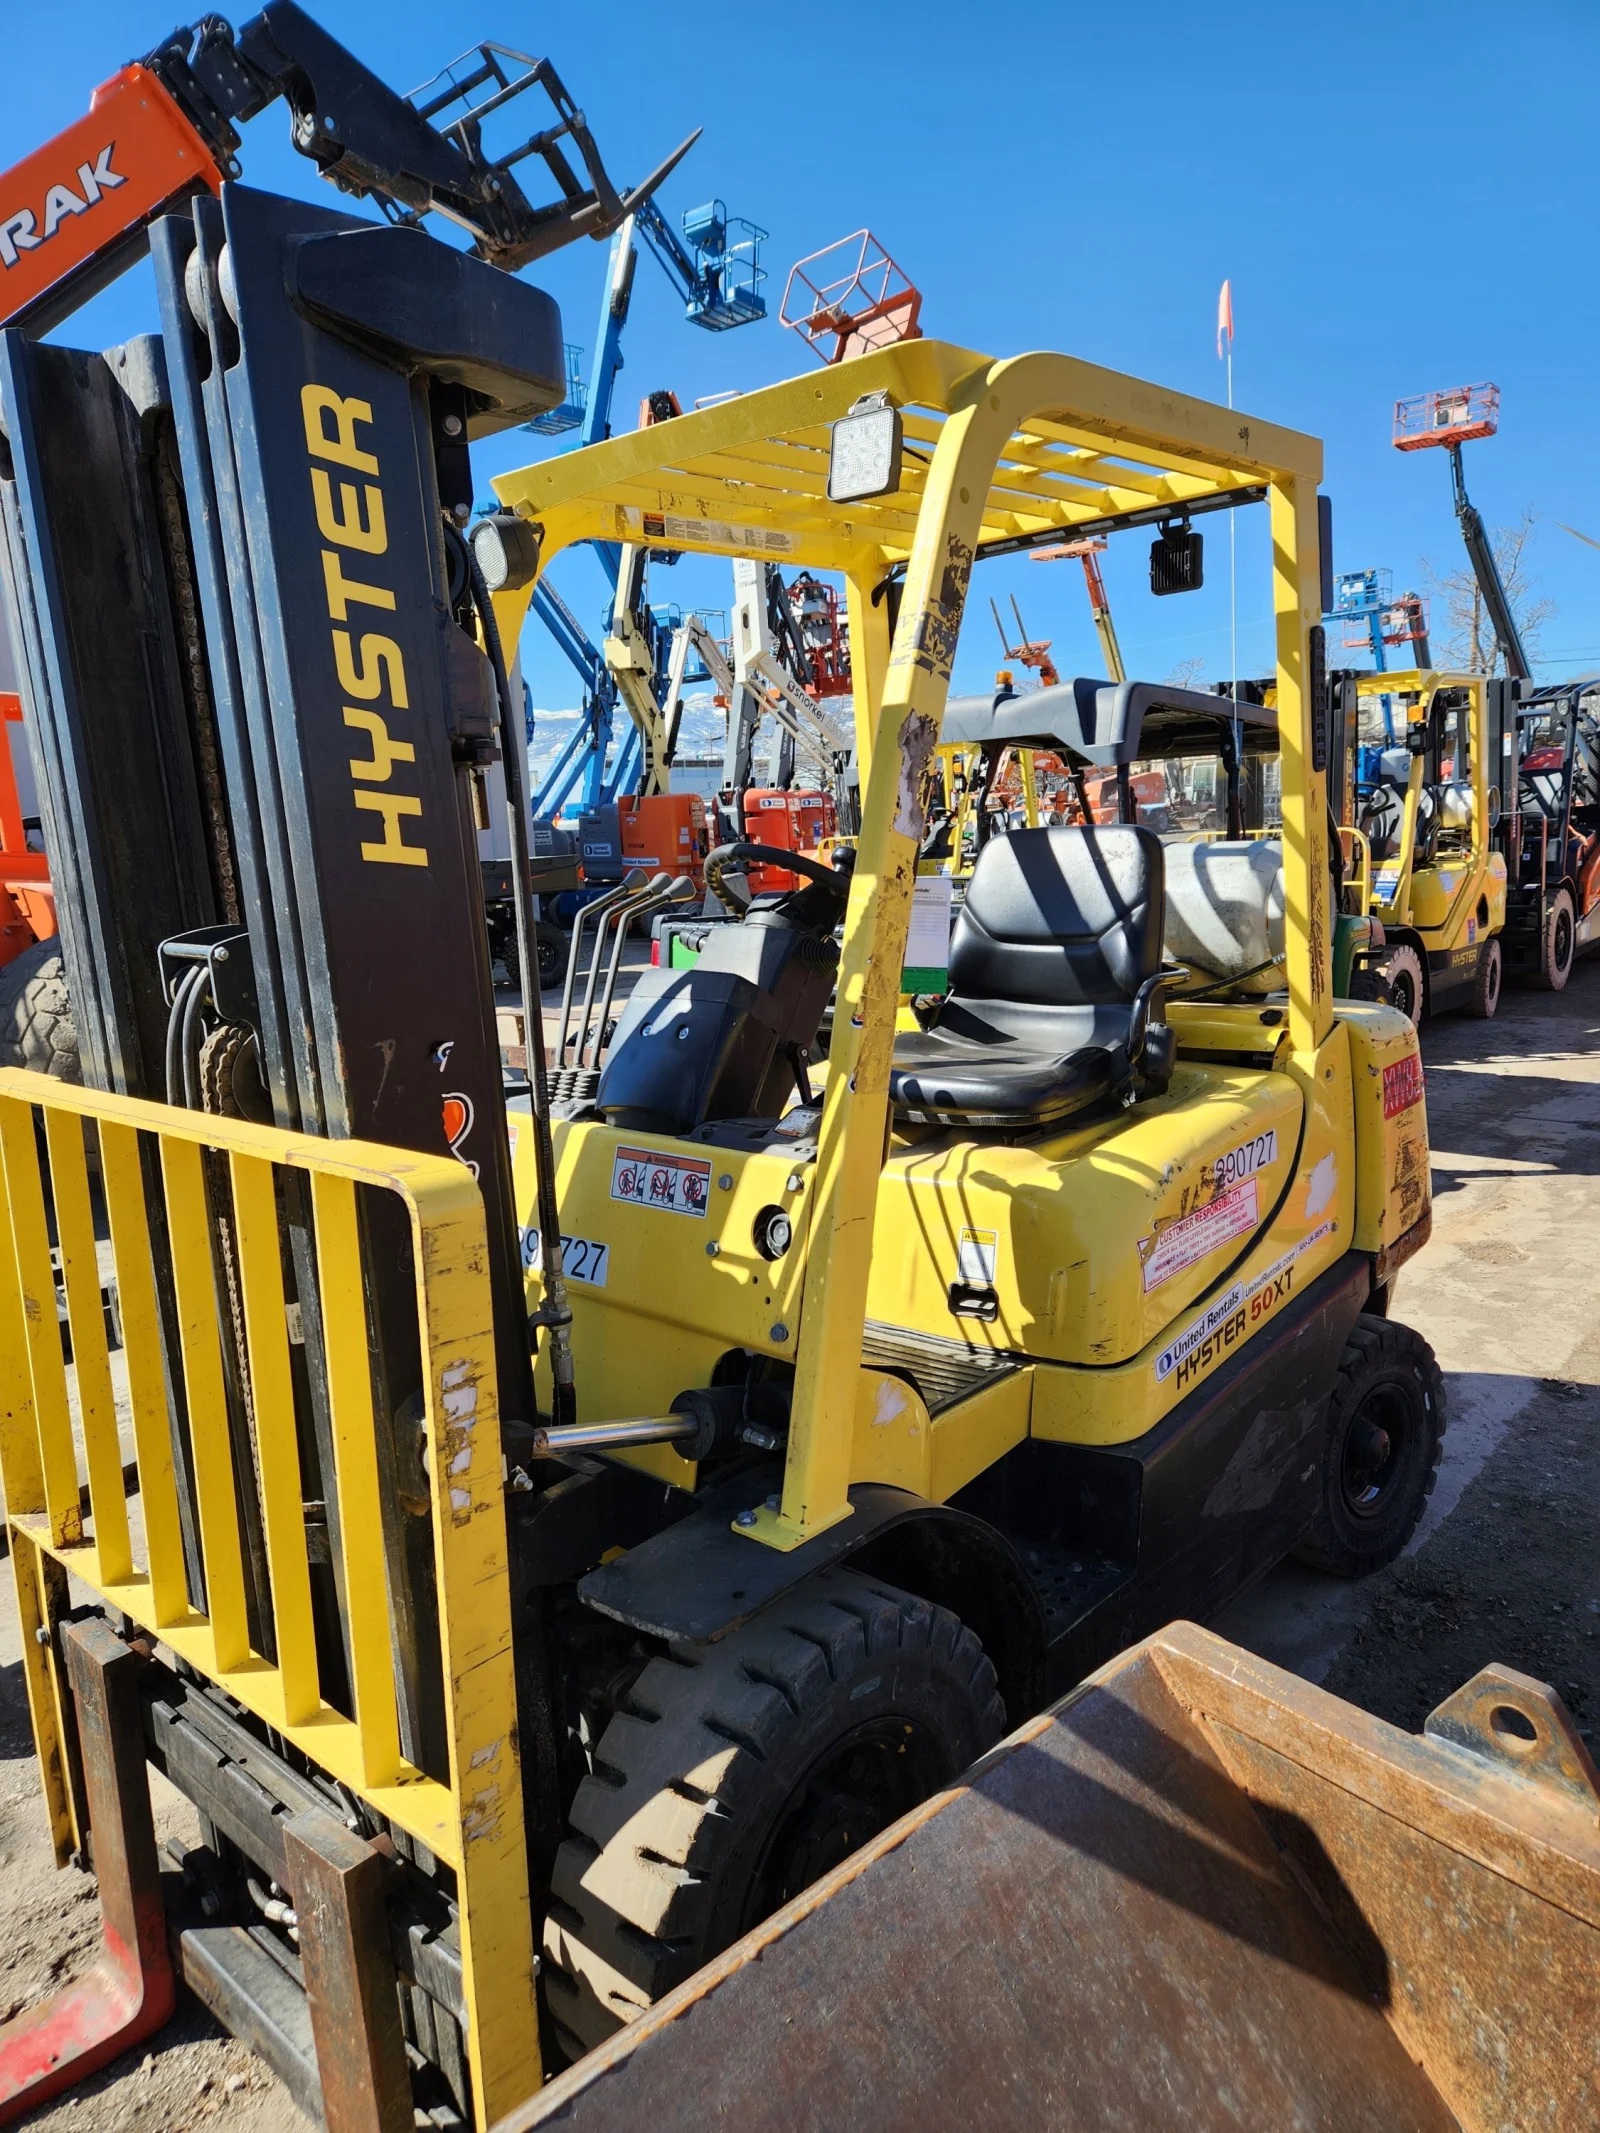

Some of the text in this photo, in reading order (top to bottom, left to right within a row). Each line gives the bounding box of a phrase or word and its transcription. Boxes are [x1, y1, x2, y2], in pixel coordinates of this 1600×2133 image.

[0, 139, 130, 271] RAK
[300, 383, 430, 868] HYSTER
[794, 688, 825, 722] snorkel
[1452, 949, 1478, 969] HYSTER
[654, 1157, 679, 1167] WARNING
[1159, 1188, 1242, 1246] CUSTOMER RESPONSIBILITY
[1246, 1251, 1296, 1298] UnitedRentals.com
[1174, 1291, 1240, 1360] United Rentals
[1176, 1265, 1295, 1390] HYSTER 50XT
